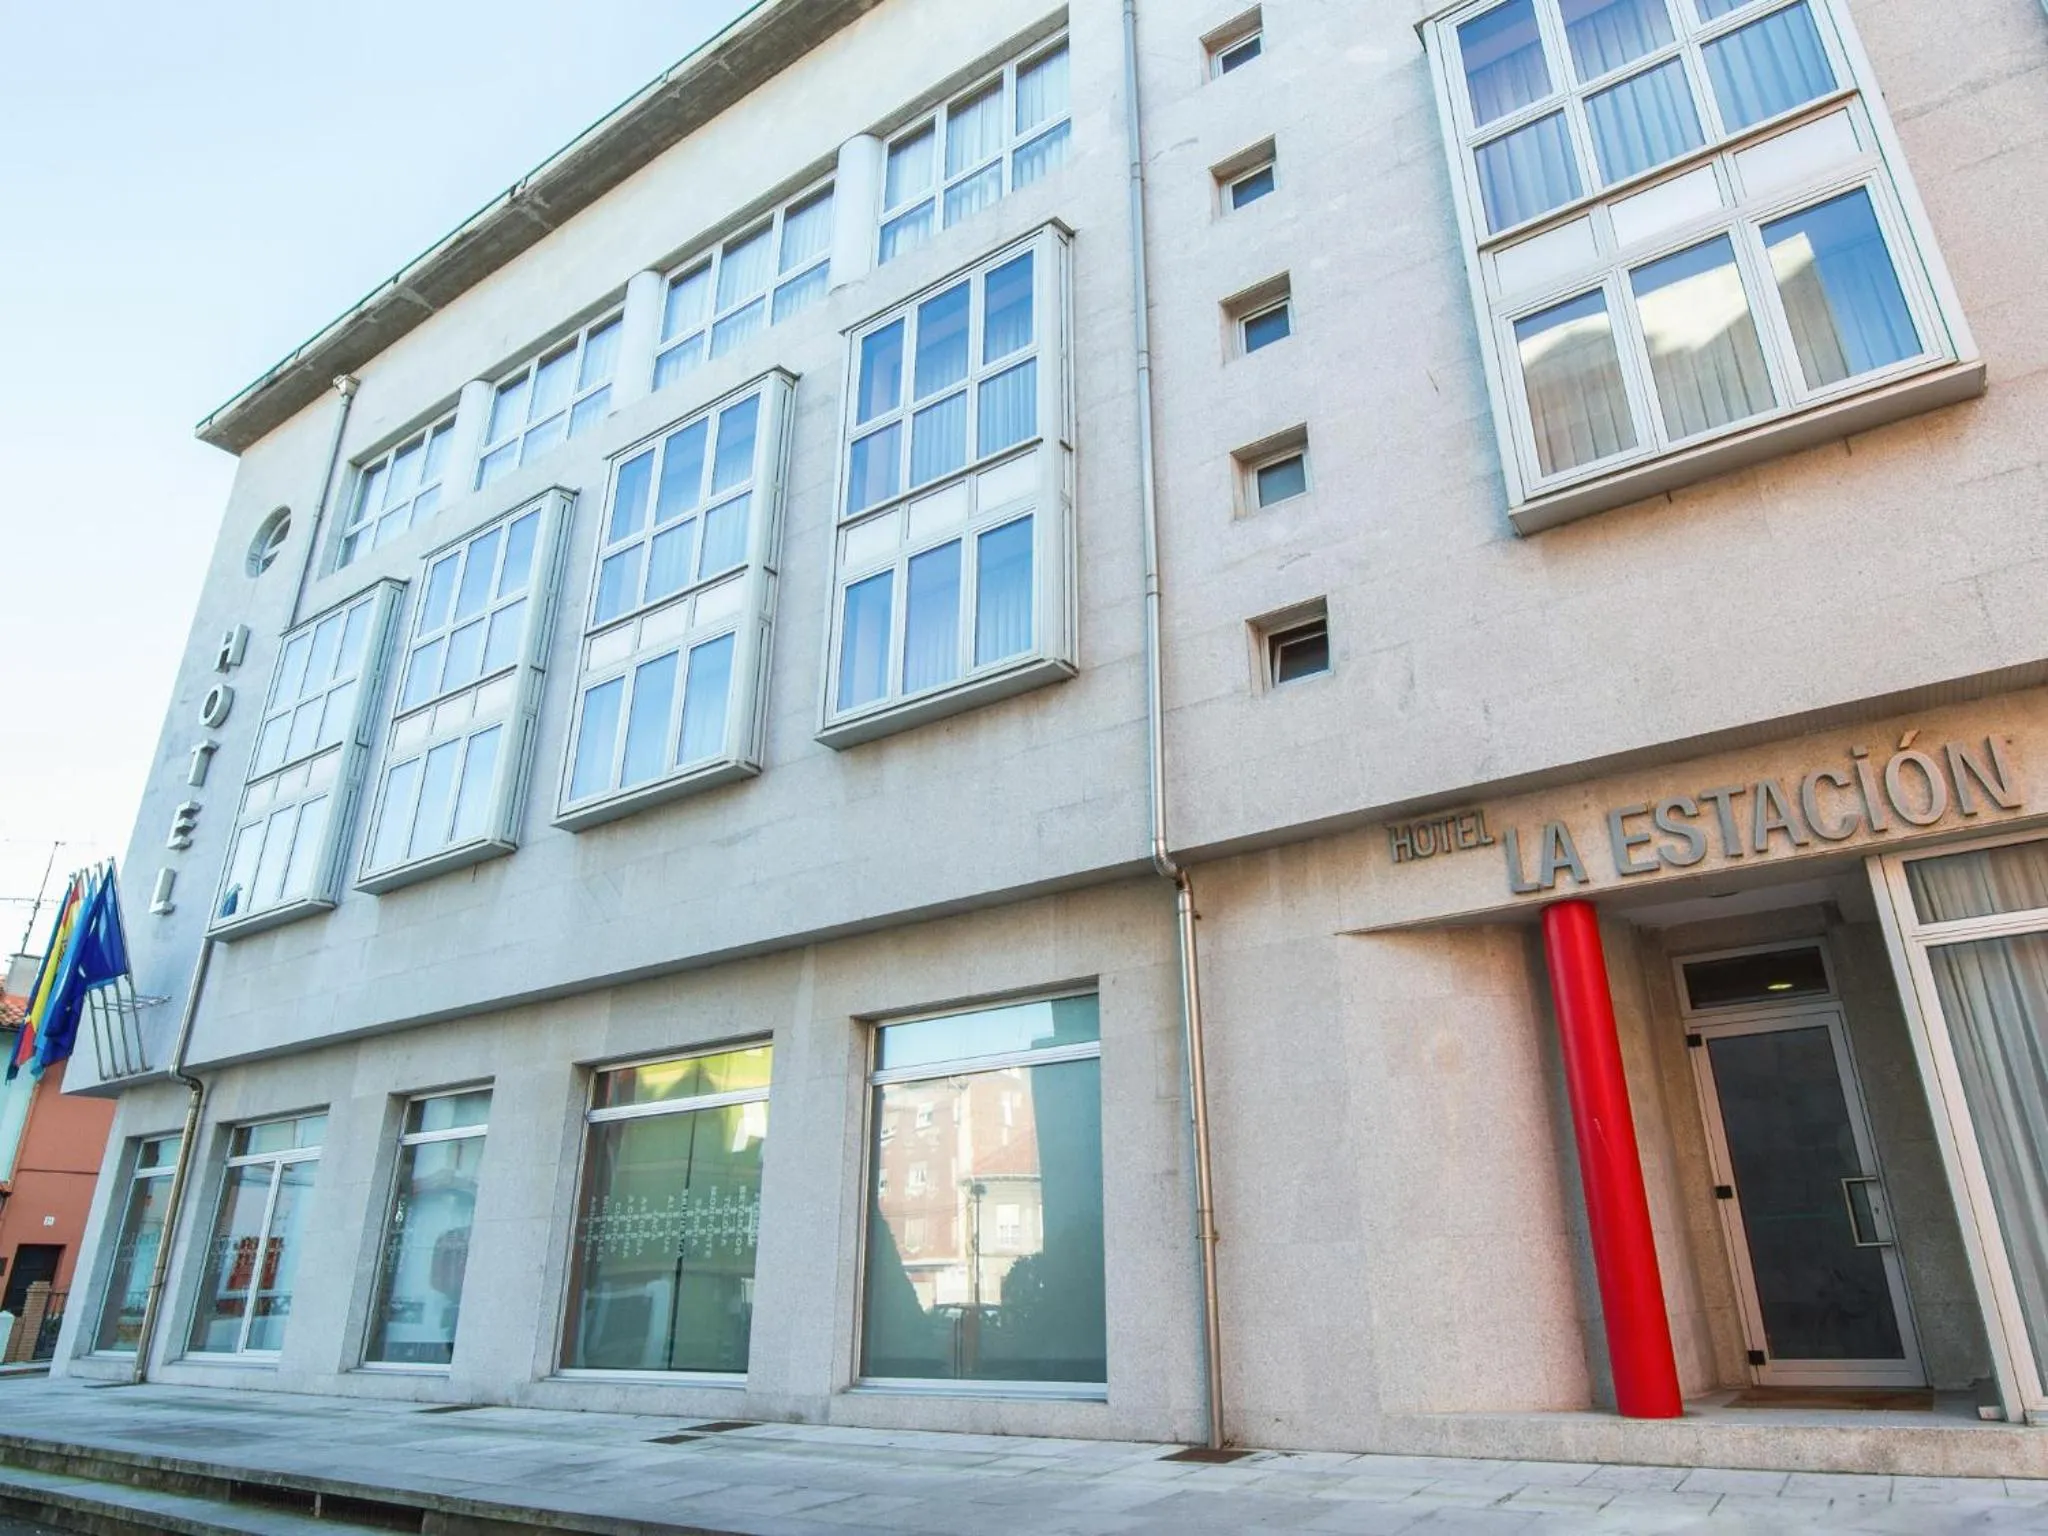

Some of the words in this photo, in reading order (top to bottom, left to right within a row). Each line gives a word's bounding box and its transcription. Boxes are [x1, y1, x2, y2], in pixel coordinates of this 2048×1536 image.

[150, 623, 249, 916] HOTEL
[1388, 809, 1494, 863] HOTEL
[1504, 818, 1591, 895] LA
